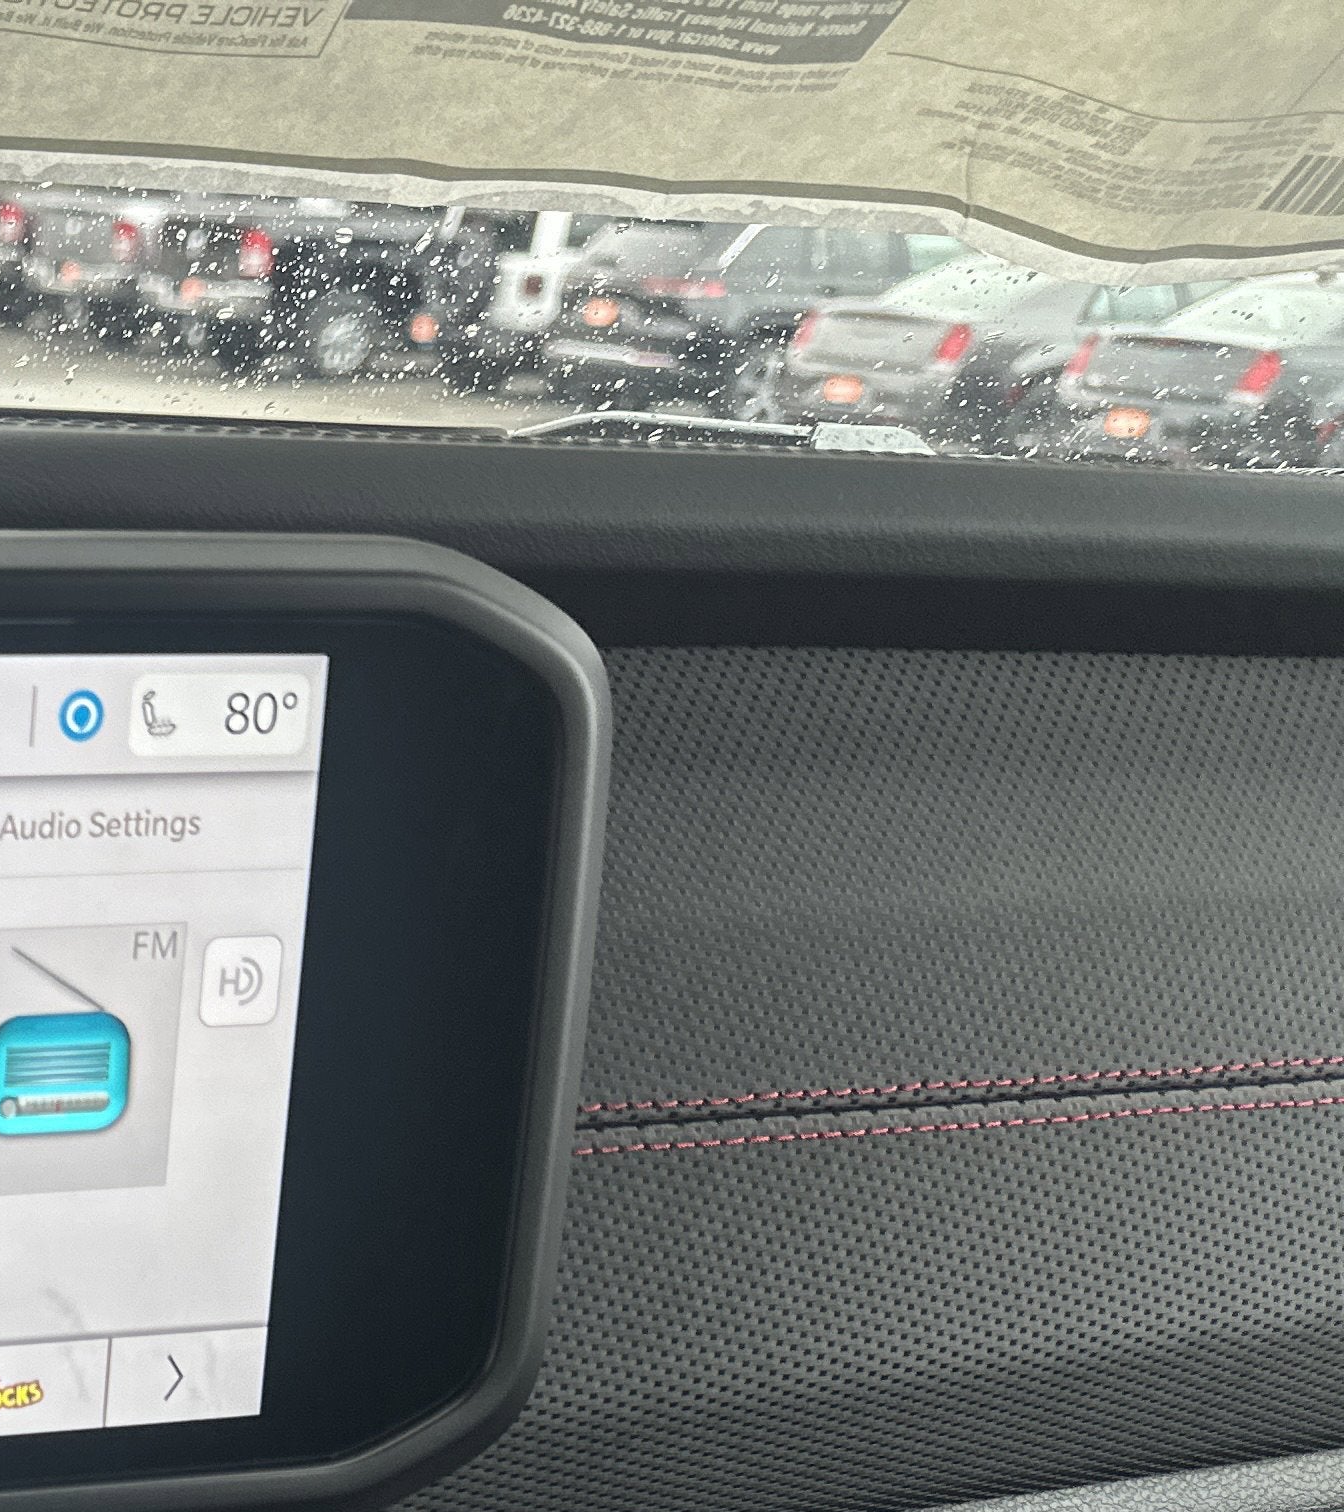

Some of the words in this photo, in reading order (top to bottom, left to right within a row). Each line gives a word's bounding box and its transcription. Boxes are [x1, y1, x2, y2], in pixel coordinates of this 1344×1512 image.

[224, 691, 299, 735] 80°
[88, 808, 202, 843] Settings
[131, 930, 179, 961] FM
